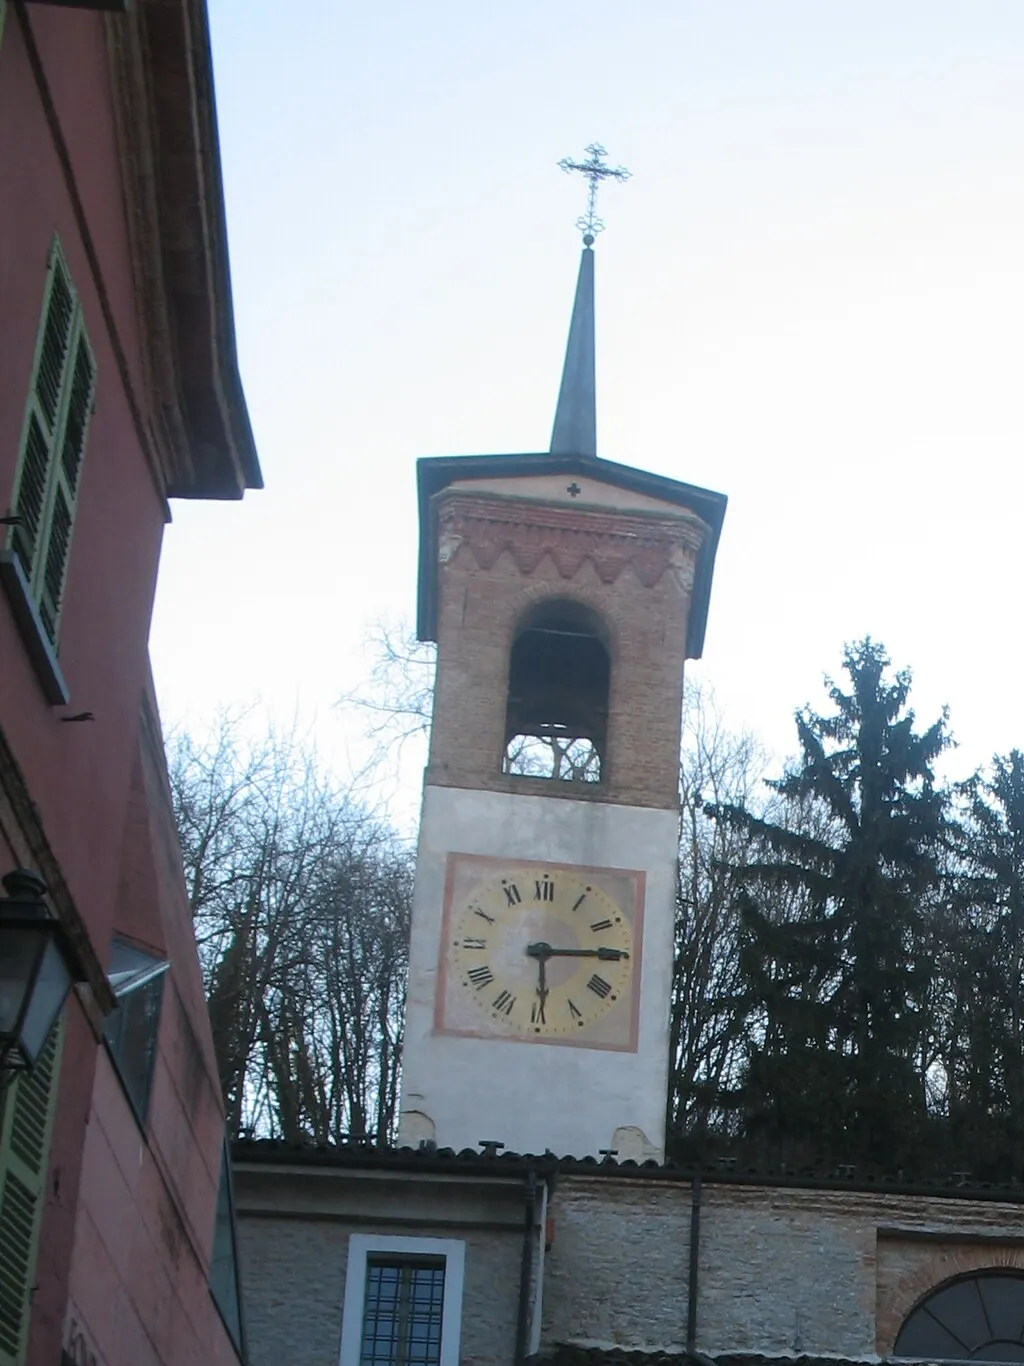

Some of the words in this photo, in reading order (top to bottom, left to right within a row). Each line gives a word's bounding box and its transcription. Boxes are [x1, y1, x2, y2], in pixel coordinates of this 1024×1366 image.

[503, 884, 522, 907] XI
[533, 880, 555, 902] XII
[474, 907, 495, 925] X
[589, 919, 613, 932] II
[467, 966, 495, 991] VIII
[492, 990, 517, 1015] VII
[567, 998, 582, 1019] V
